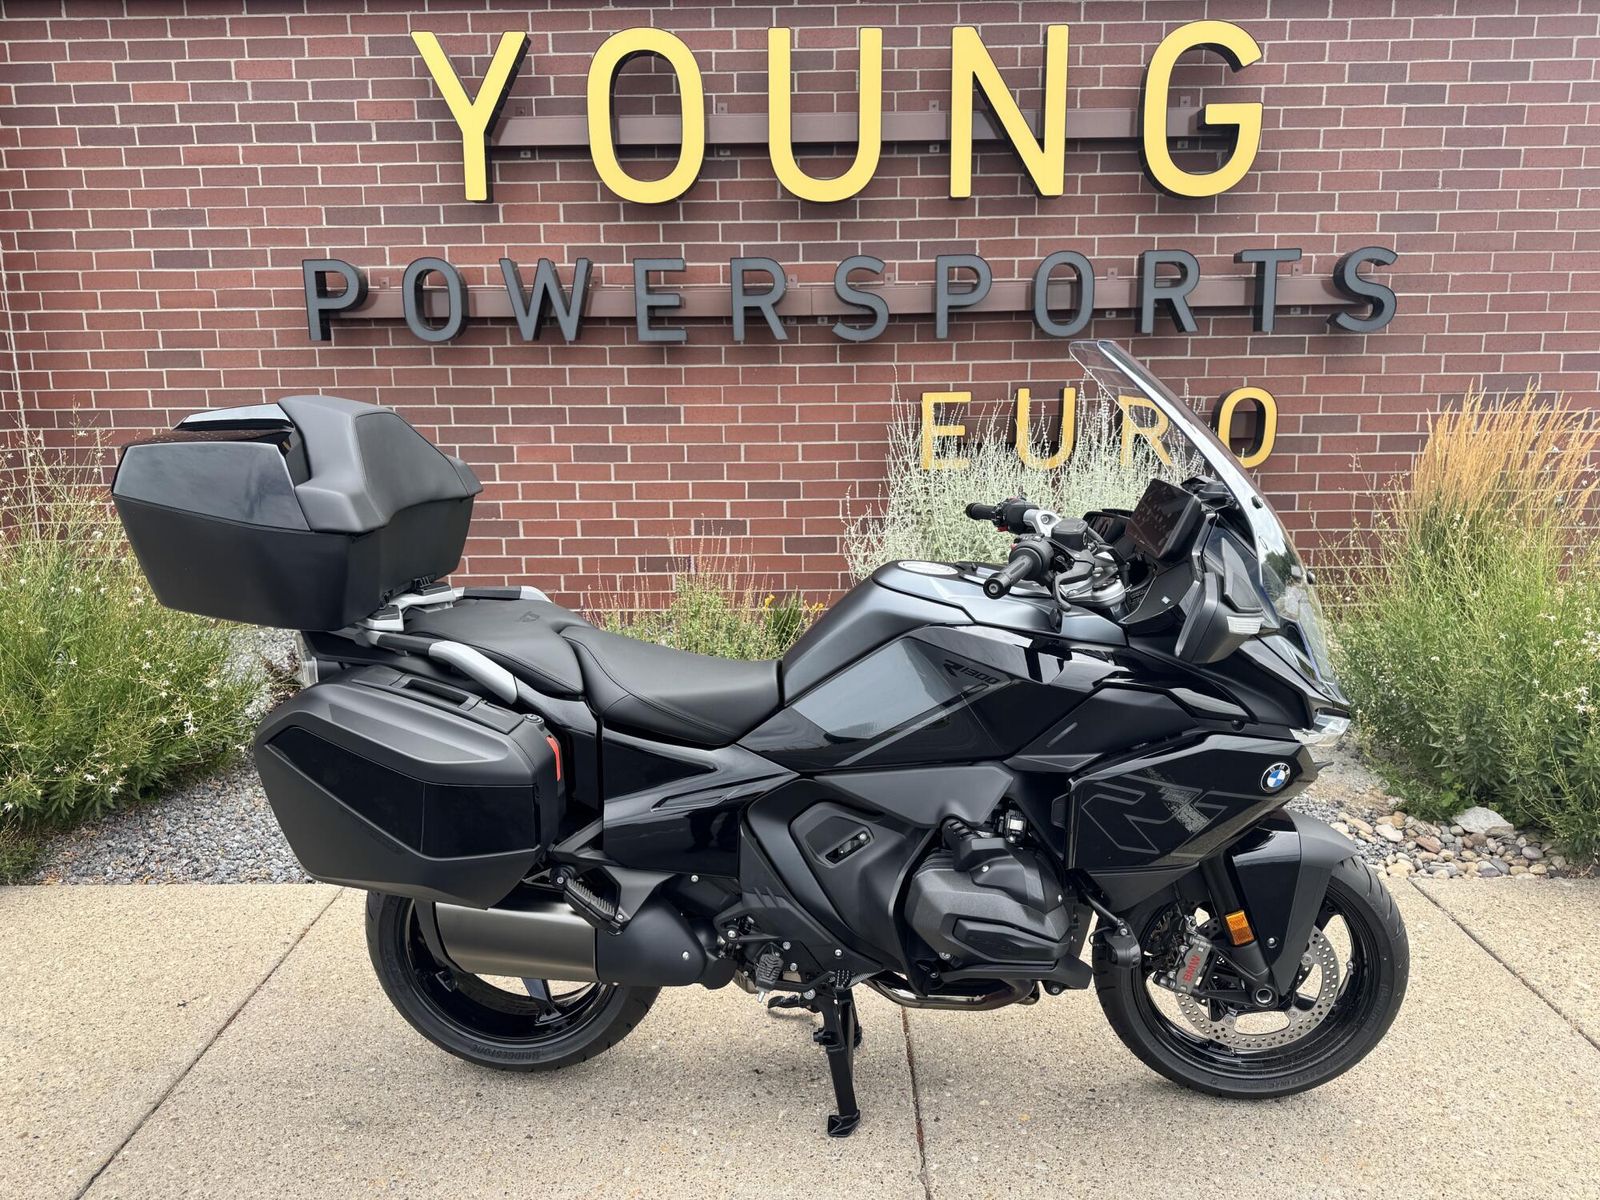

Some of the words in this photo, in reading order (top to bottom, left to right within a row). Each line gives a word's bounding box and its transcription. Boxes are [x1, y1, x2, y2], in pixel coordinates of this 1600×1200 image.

[410, 19, 1264, 205] YOUNG
[302, 246, 1398, 343] POWERSPORTS
[920, 386, 1279, 471] EURO
[1183, 954, 1201, 982] BMW
